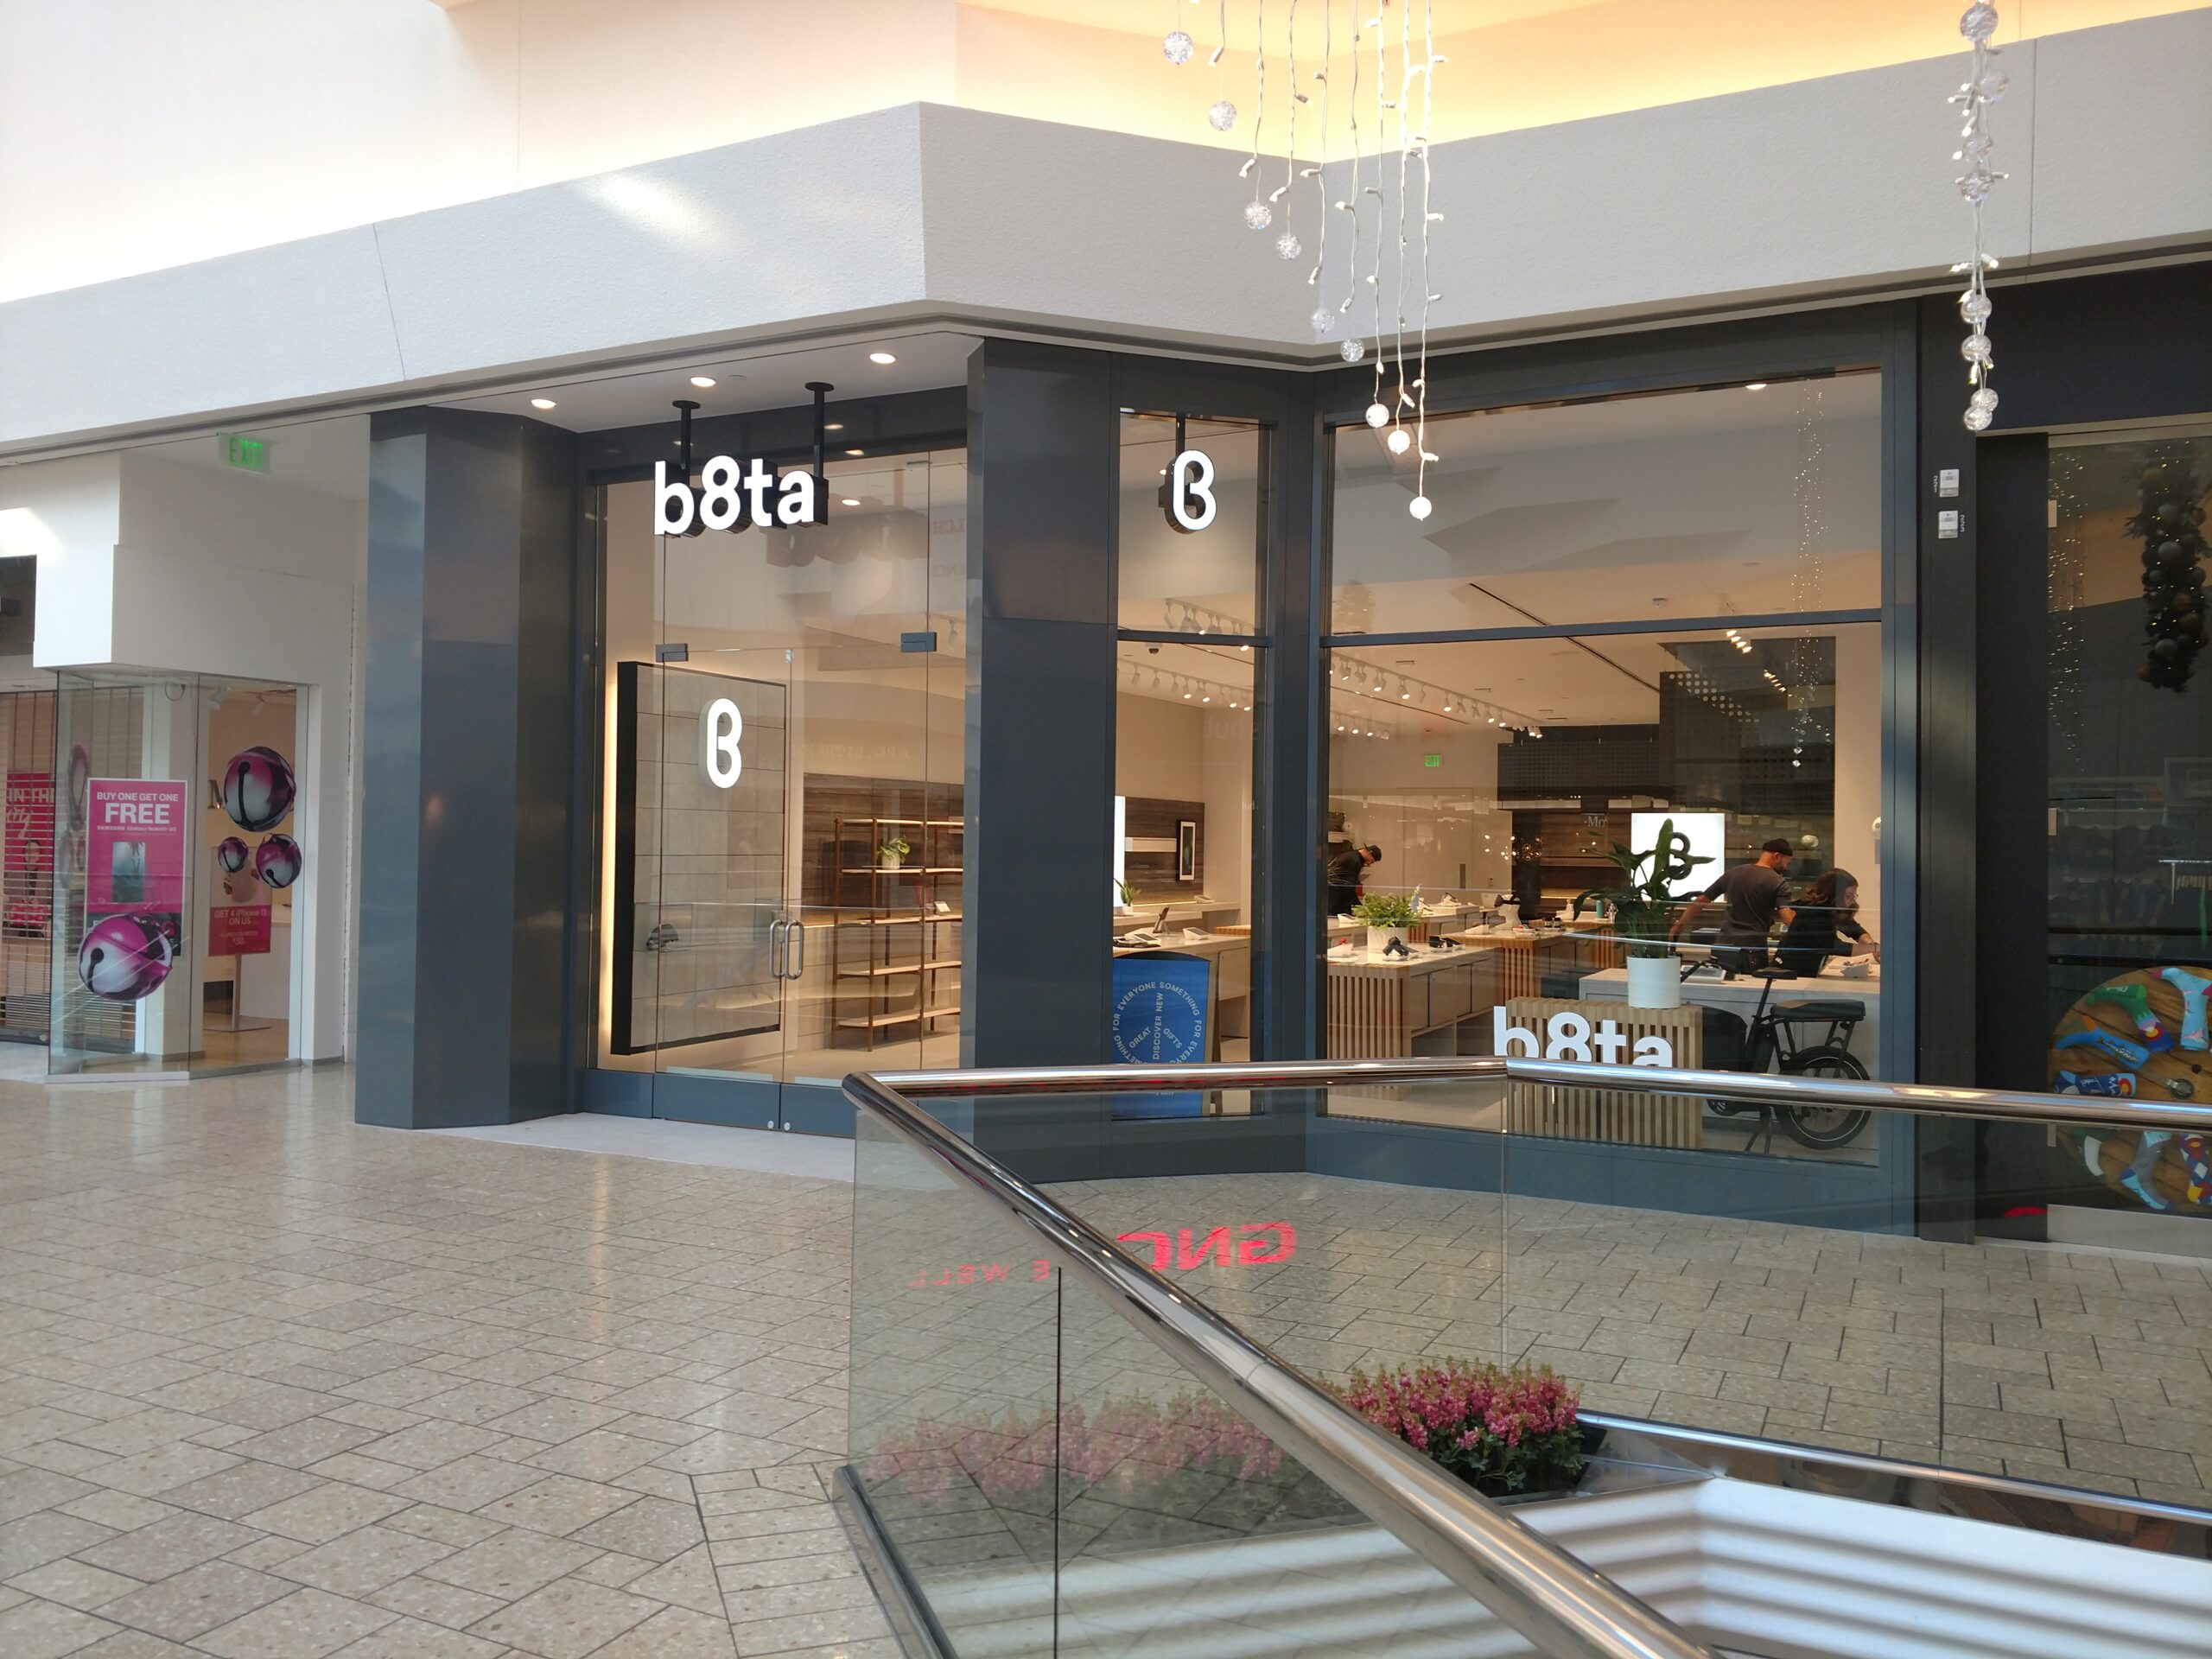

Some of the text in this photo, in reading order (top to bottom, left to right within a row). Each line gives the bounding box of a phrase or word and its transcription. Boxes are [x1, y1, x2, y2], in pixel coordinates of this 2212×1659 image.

[229, 438, 264, 471] EXIT
[654, 455, 814, 536] b8ta
[97, 791, 117, 801] BUY
[118, 792, 137, 801] ONE
[138, 793, 157, 802] GET
[105, 803, 170, 824] FREE
[214, 910, 230, 918] GET
[228, 917, 251, 926] ON US
[1116, 982, 1156, 1010] EVERYONE
[1159, 982, 1200, 1016] SOMETHING
[1112, 1013, 1122, 1031] FOR
[1152, 992, 1164, 1060] DISCOVER NEW
[1128, 1027, 1152, 1048] GREAT
[1163, 1027, 1182, 1048] GIFTS
